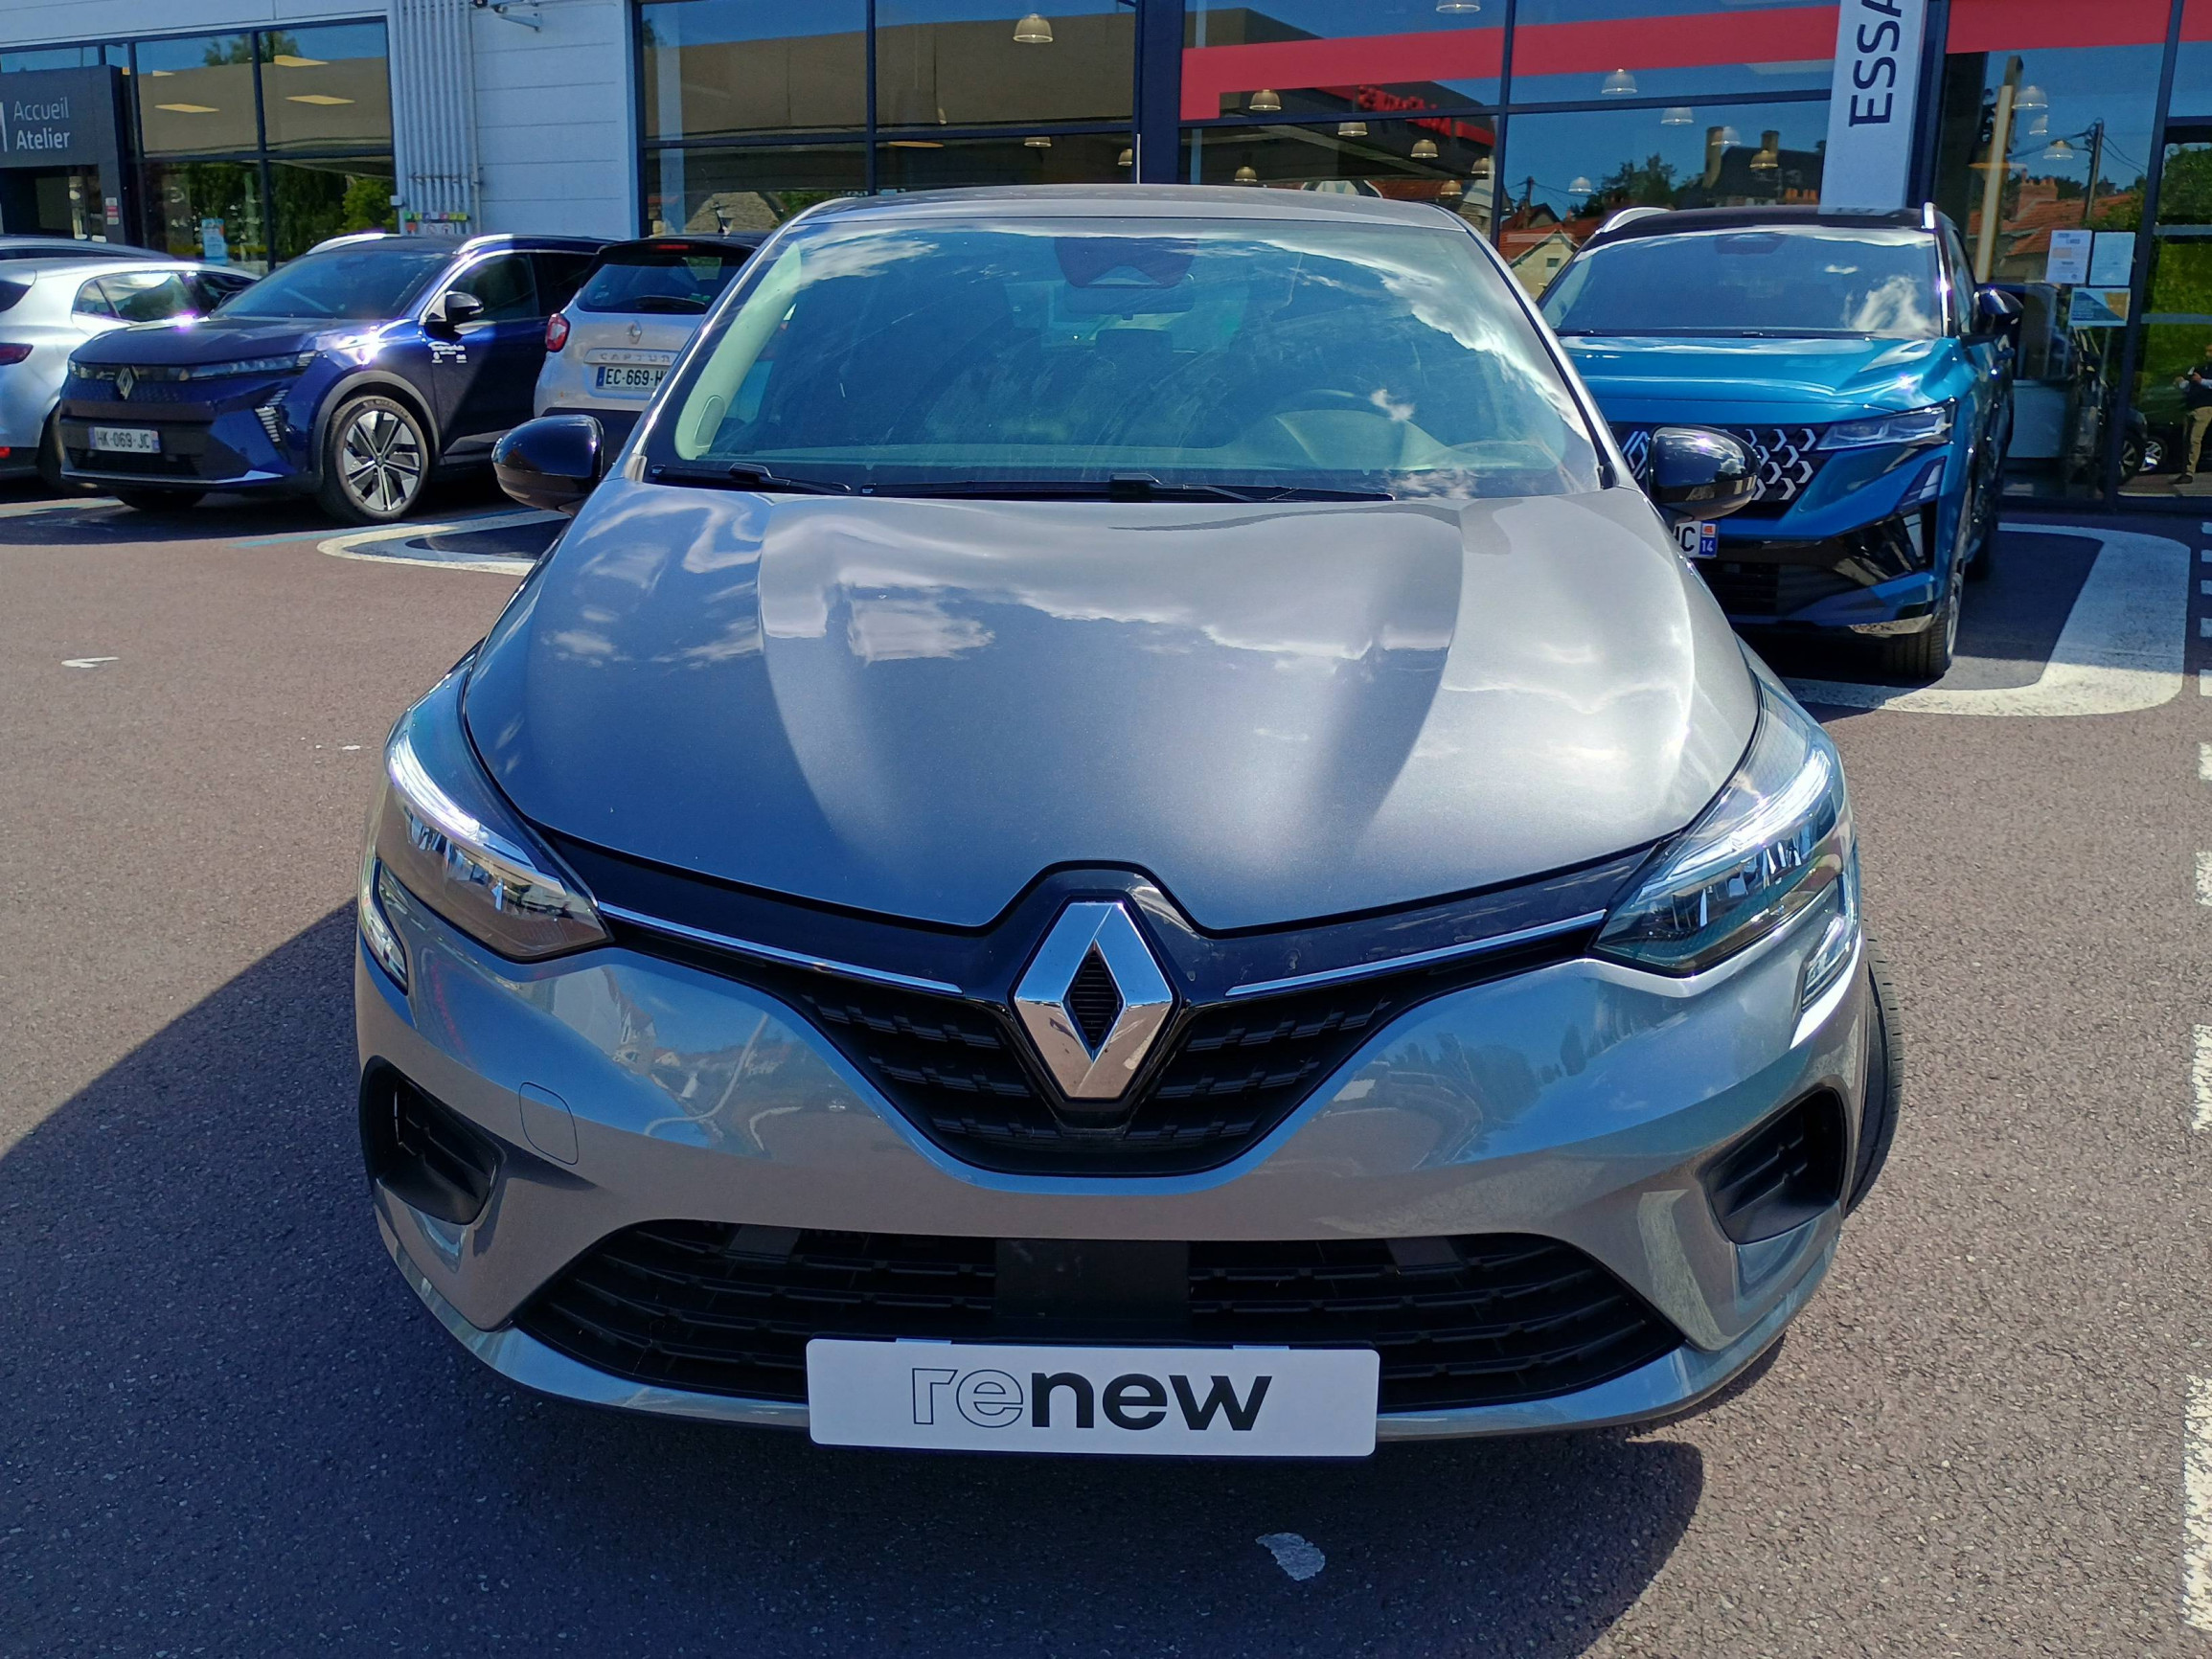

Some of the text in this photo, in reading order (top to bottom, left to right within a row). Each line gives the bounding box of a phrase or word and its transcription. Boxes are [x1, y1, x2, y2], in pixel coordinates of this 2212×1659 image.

[13, 96, 70, 122] Accueil
[15, 126, 71, 150] Atelier
[605, 368, 669, 386] EC-669-H
[1701, 539, 1714, 553] 14
[911, 1367, 1272, 1432] renew
